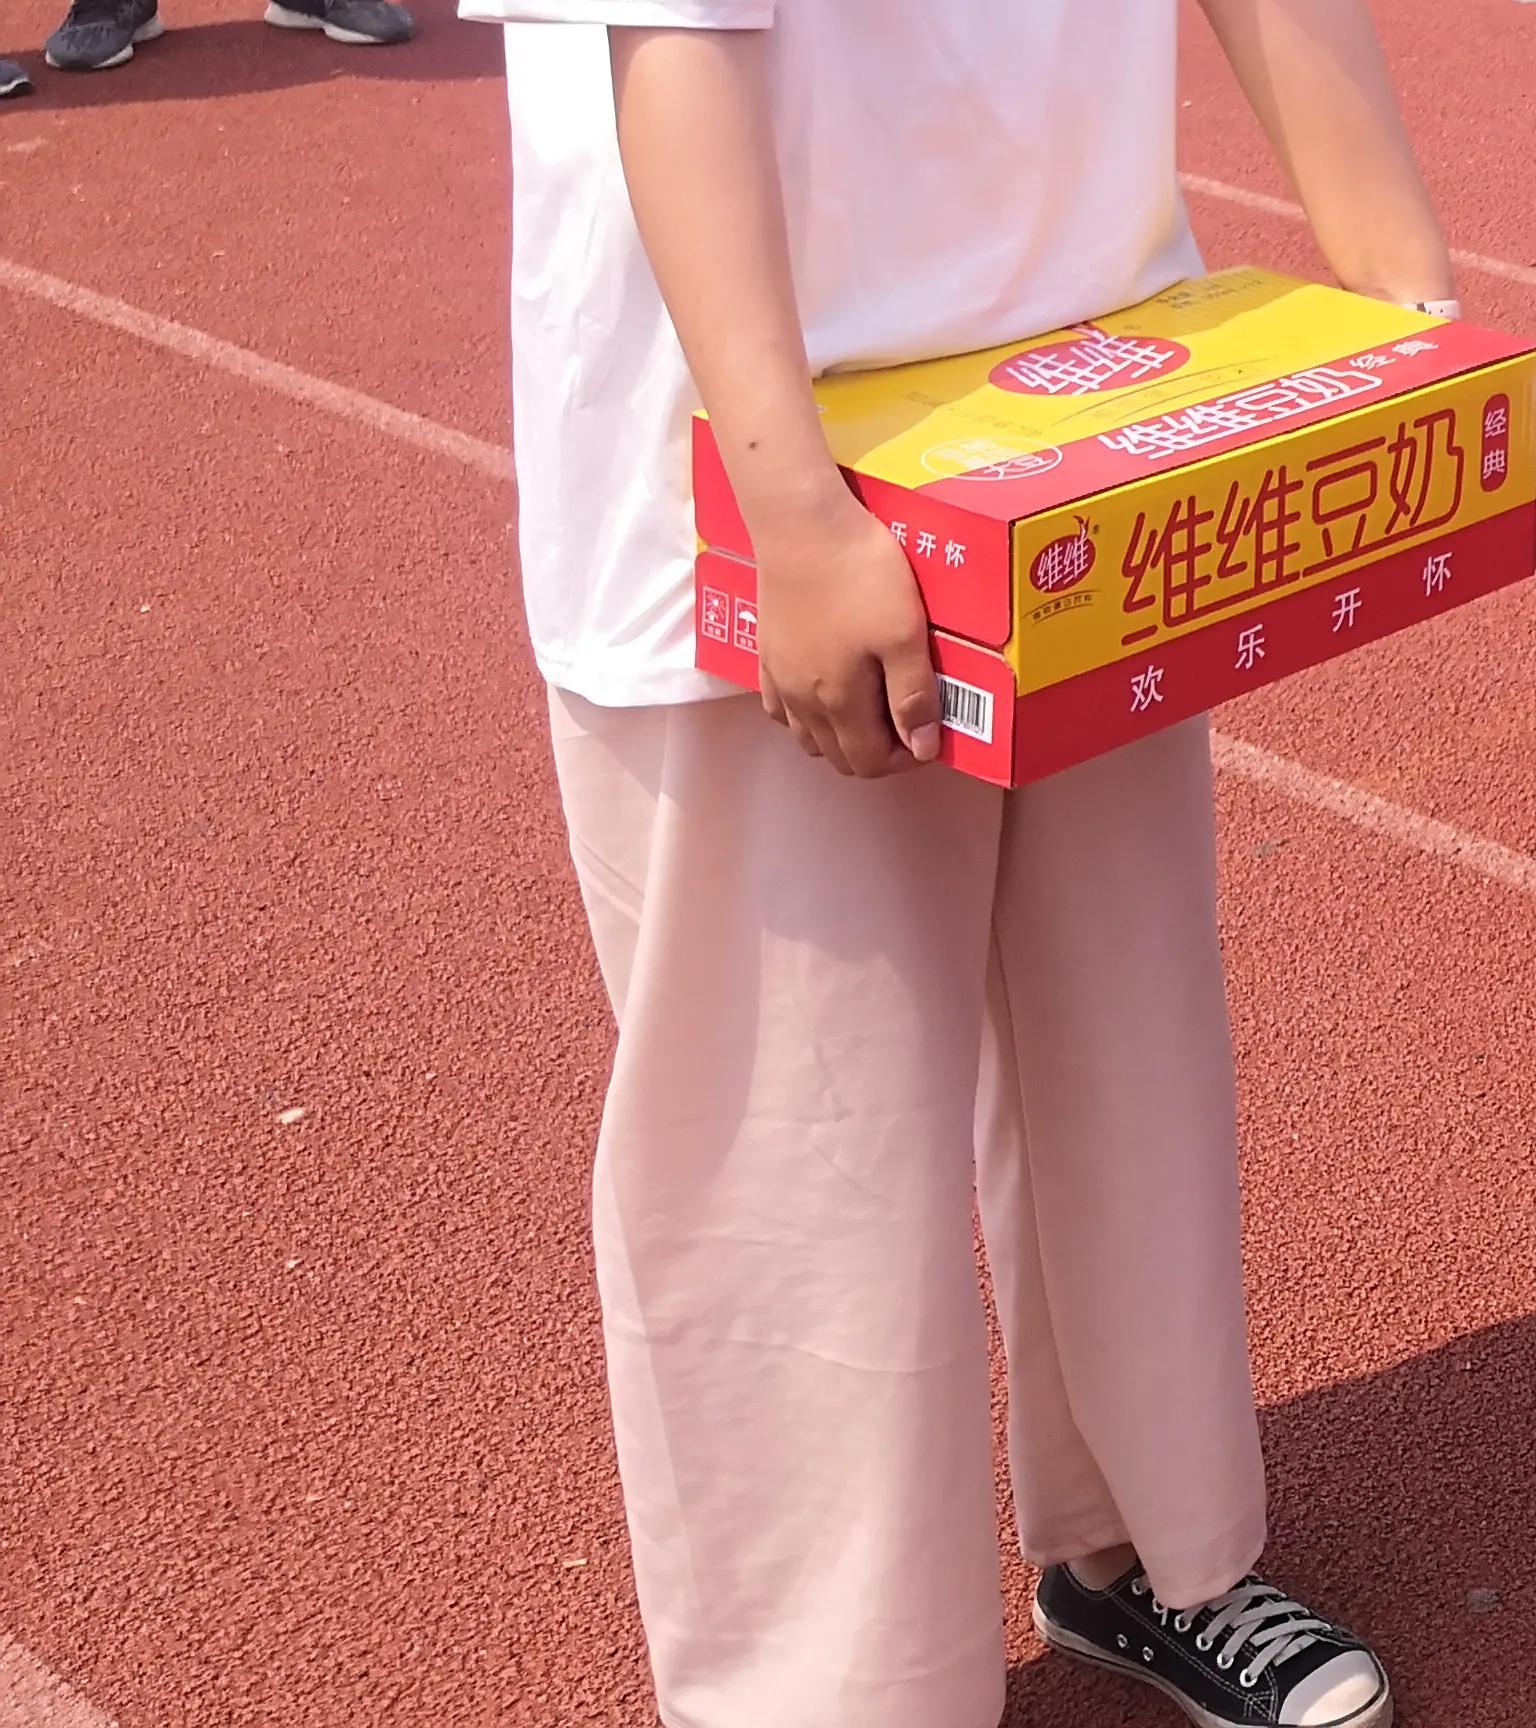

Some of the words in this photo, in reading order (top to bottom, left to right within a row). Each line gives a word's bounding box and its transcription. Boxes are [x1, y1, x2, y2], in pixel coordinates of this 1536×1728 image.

[1004, 332, 1176, 397] 维维
[1098, 366, 1384, 460] 维维豆奶
[1482, 405, 1508, 481] 经典
[889, 520, 968, 569] 乐开怀
[1036, 526, 1090, 593] 维维
[1120, 407, 1465, 647] 维维豆奶
[1129, 551, 1453, 713] 欢乐开怀
